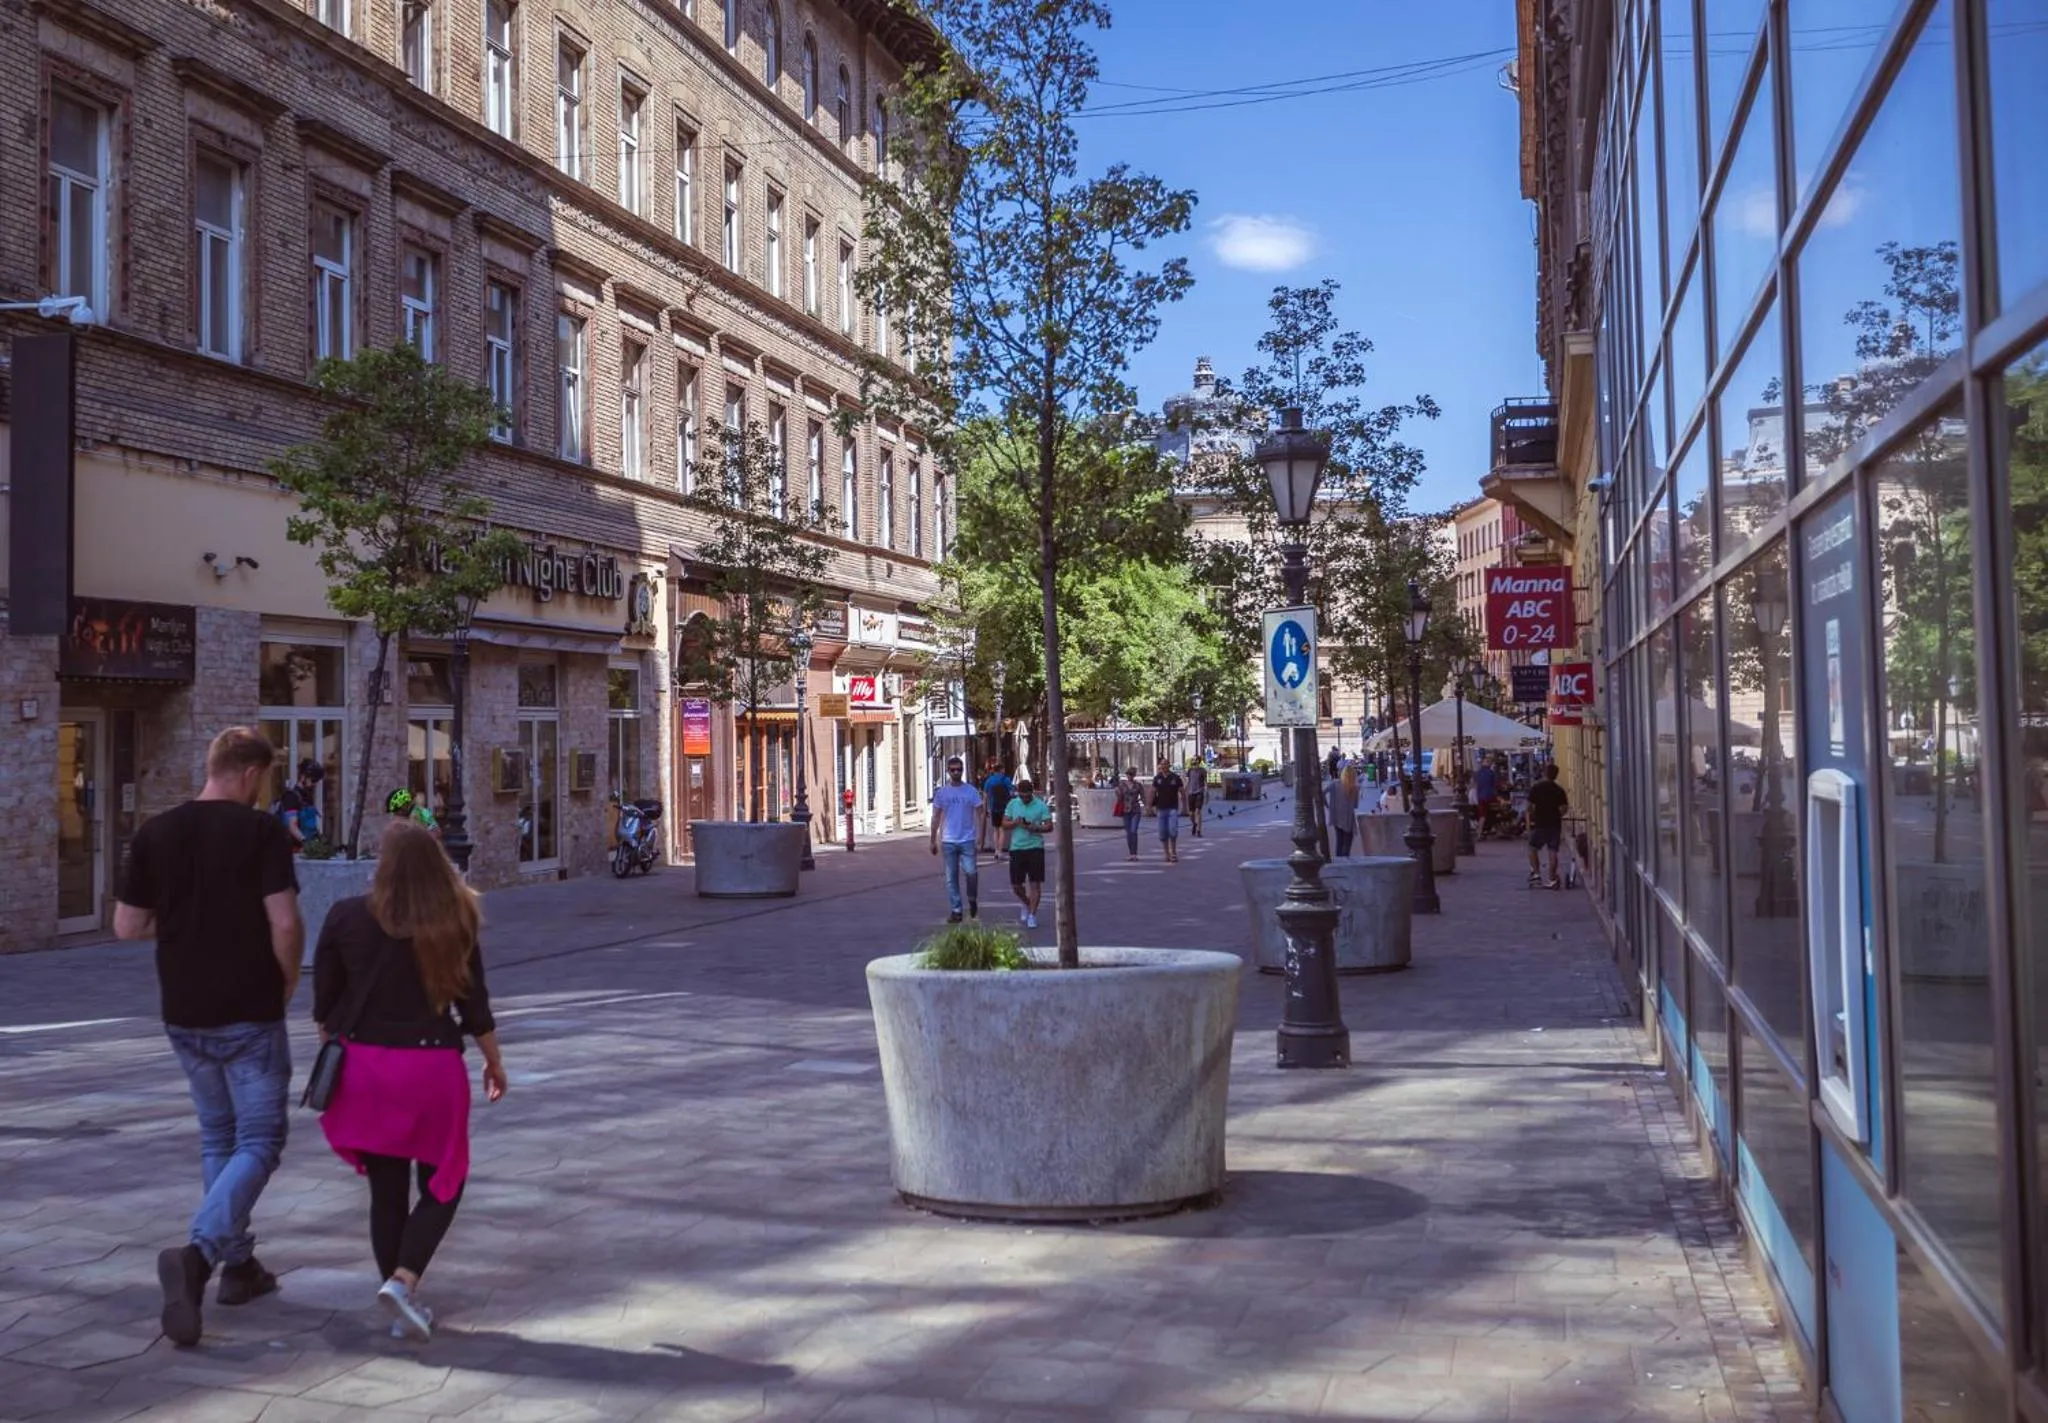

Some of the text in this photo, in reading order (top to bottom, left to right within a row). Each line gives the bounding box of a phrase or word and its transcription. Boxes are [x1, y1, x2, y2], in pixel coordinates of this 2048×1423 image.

[516, 545, 577, 603] Night
[582, 552, 625, 601] Club
[1490, 575, 1565, 594] Manna
[1506, 600, 1552, 618] ABC
[1503, 624, 1556, 644] 0-24
[852, 681, 874, 700] illy
[1550, 673, 1588, 697] ABC
